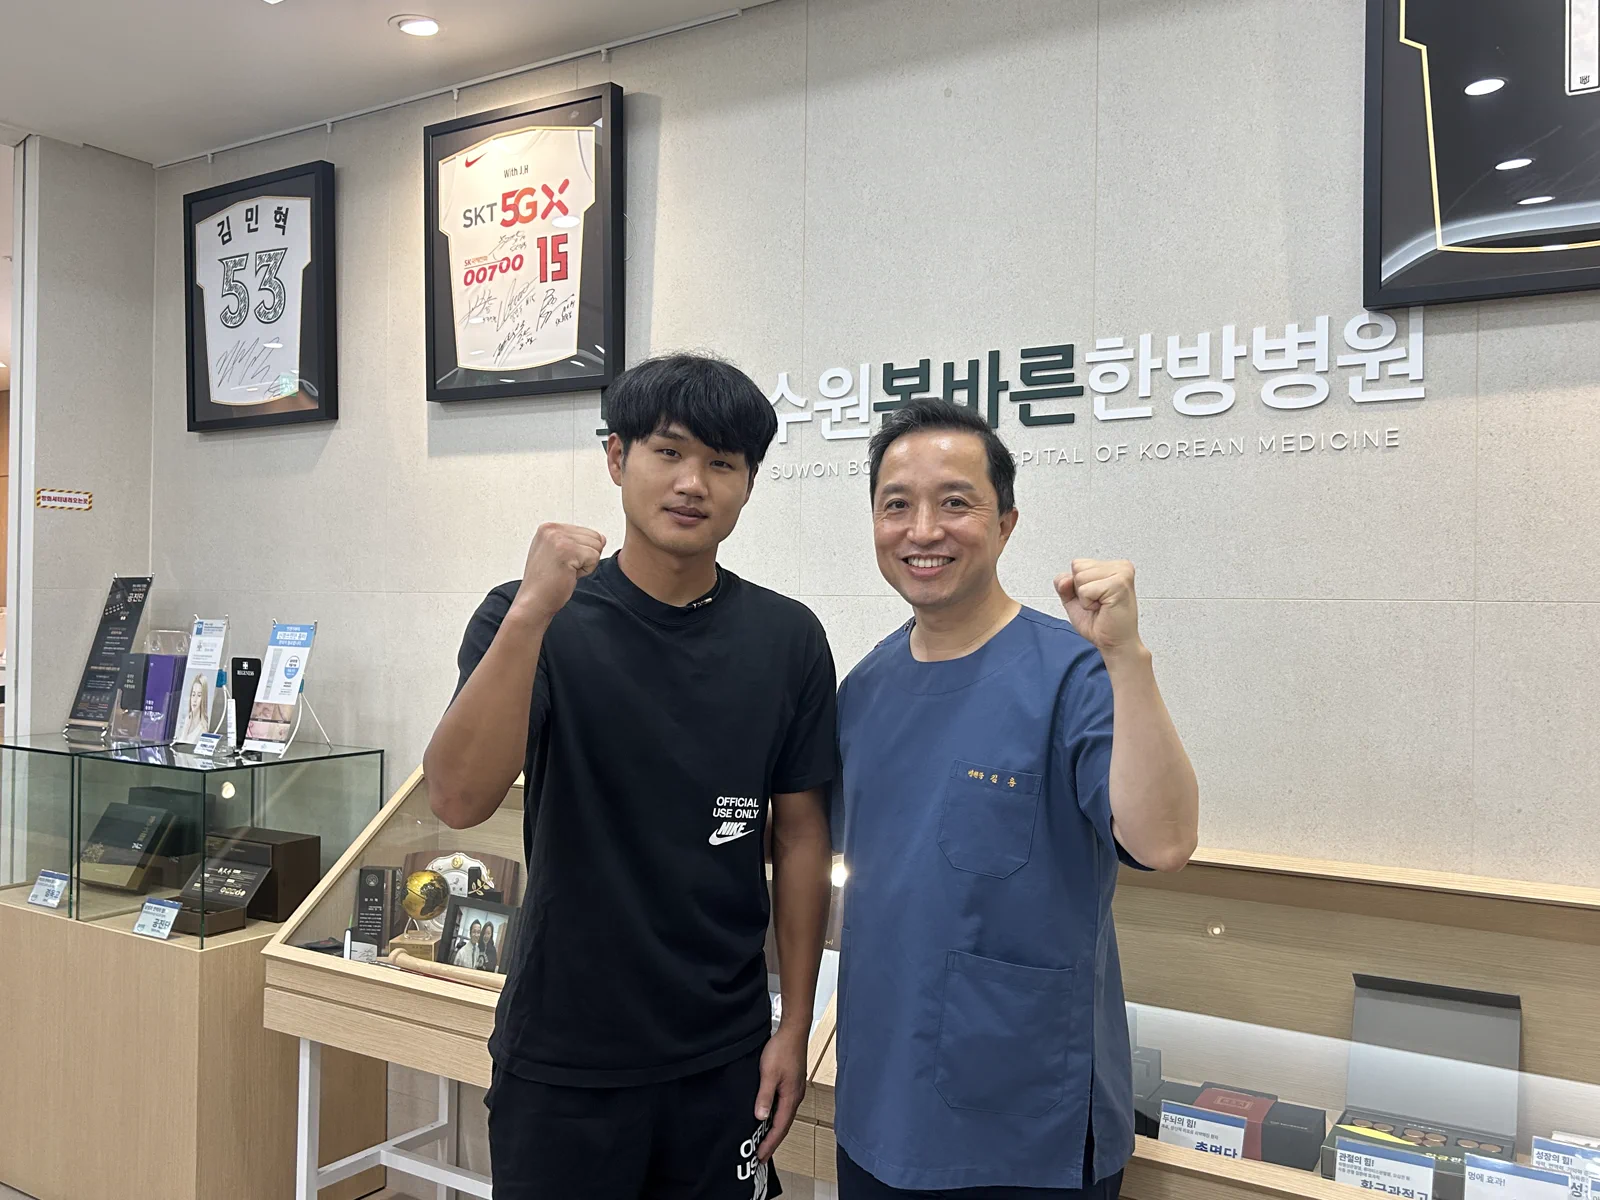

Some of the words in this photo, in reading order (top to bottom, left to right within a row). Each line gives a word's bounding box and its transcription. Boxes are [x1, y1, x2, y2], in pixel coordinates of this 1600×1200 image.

[504, 168, 518, 178] With
[463, 203, 497, 228] SKT
[500, 178, 570, 228] 5GX
[536, 233, 568, 284] 15
[463, 254, 524, 287] 00700
[218, 247, 288, 328] 53
[770, 461, 839, 480] SUWON
[1095, 444, 1129, 463] OF
[1139, 436, 1246, 462] KOREAN
[1258, 428, 1400, 454] MEDICINE
[716, 796, 759, 808] OFFICIAL
[712, 808, 733, 818] USE
[734, 808, 760, 819] ONLY
[717, 821, 748, 836] NIKE
[1162, 1113, 1185, 1127] 두뇌의
[1186, 1118, 1197, 1129] 힘!
[1338, 1152, 1362, 1165] 관절의
[1364, 1157, 1375, 1167] 힘!
[1535, 1150, 1560, 1163] 성장의
[1562, 1156, 1573, 1166] 힘!
[1468, 1171, 1484, 1183] 멍에
[1486, 1175, 1505, 1187] 효과!
